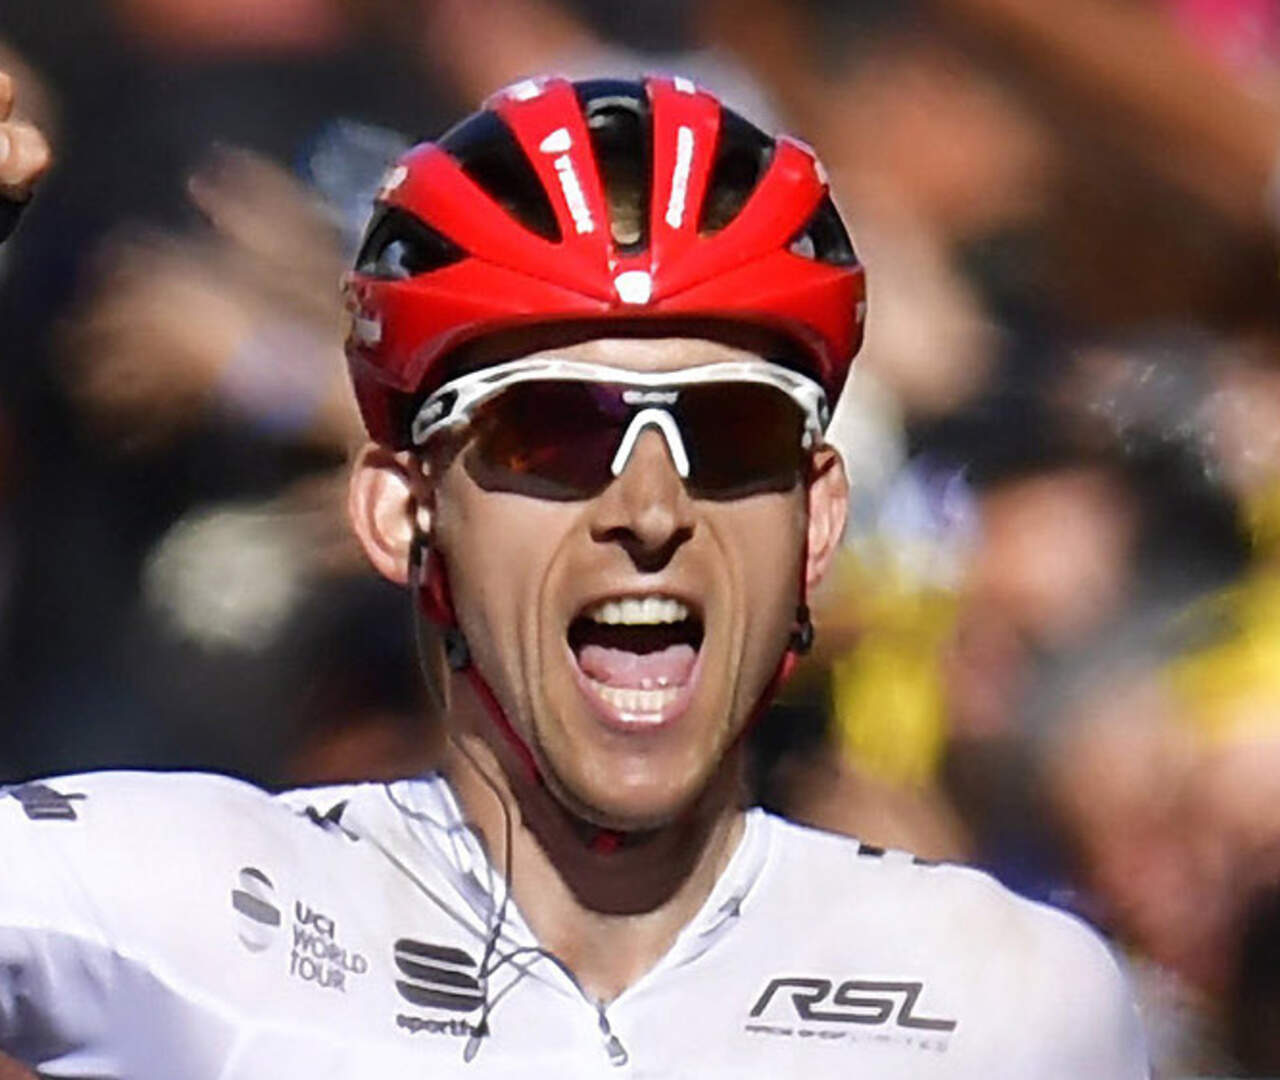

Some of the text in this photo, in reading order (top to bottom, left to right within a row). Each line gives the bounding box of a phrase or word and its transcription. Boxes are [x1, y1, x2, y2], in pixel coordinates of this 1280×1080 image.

[294, 900, 335, 939] UCI
[290, 948, 346, 993] TOUR
[293, 923, 368, 975] WORLD
[749, 977, 957, 1032] RSL
